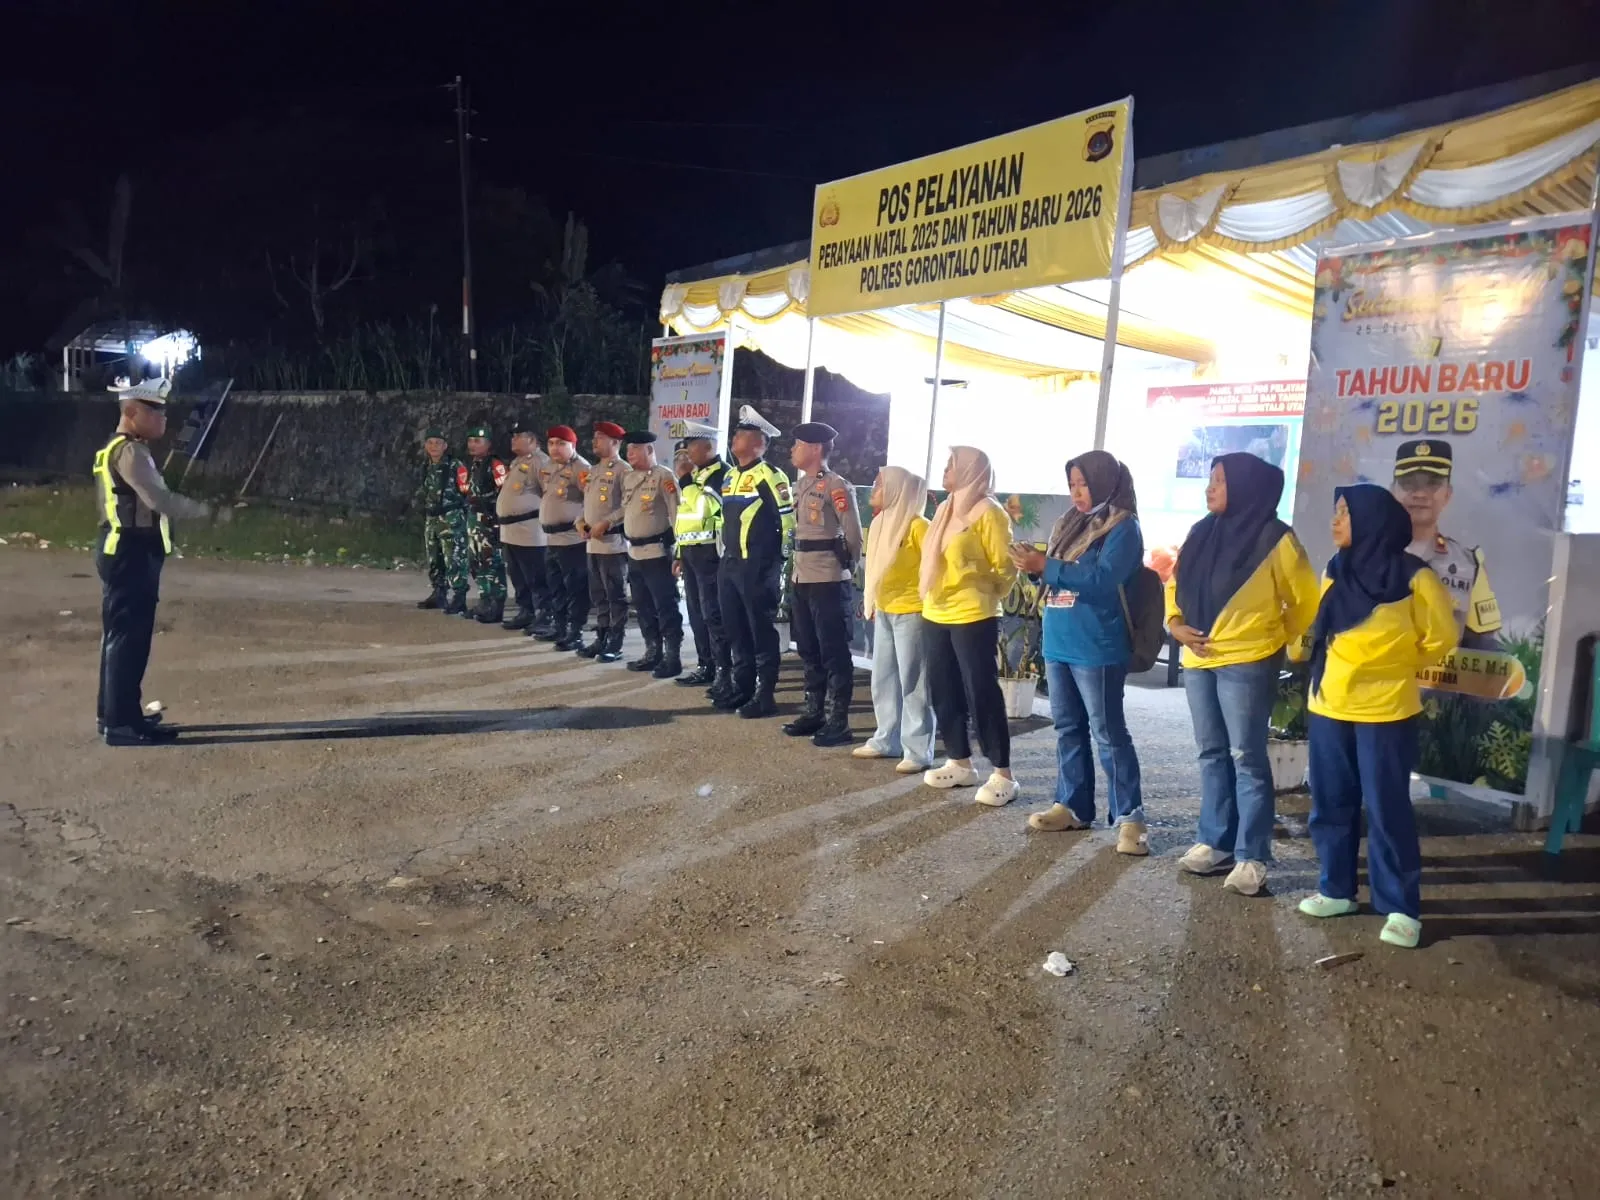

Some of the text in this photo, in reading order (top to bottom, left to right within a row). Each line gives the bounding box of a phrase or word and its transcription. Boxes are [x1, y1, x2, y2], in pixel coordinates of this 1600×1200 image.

[877, 152, 1024, 226] POS PELAYANAN
[819, 184, 1102, 270] PERAYAAN NATAL 2025 DAN TAHUN BARU 2026
[860, 237, 1028, 293] POLRES GORONTALO UTARA
[1335, 359, 1532, 397] TAHUN BARU
[658, 403, 710, 419] TAHUN BARU
[1377, 398, 1480, 434] 2026
[1441, 576, 1470, 592] OLRI
